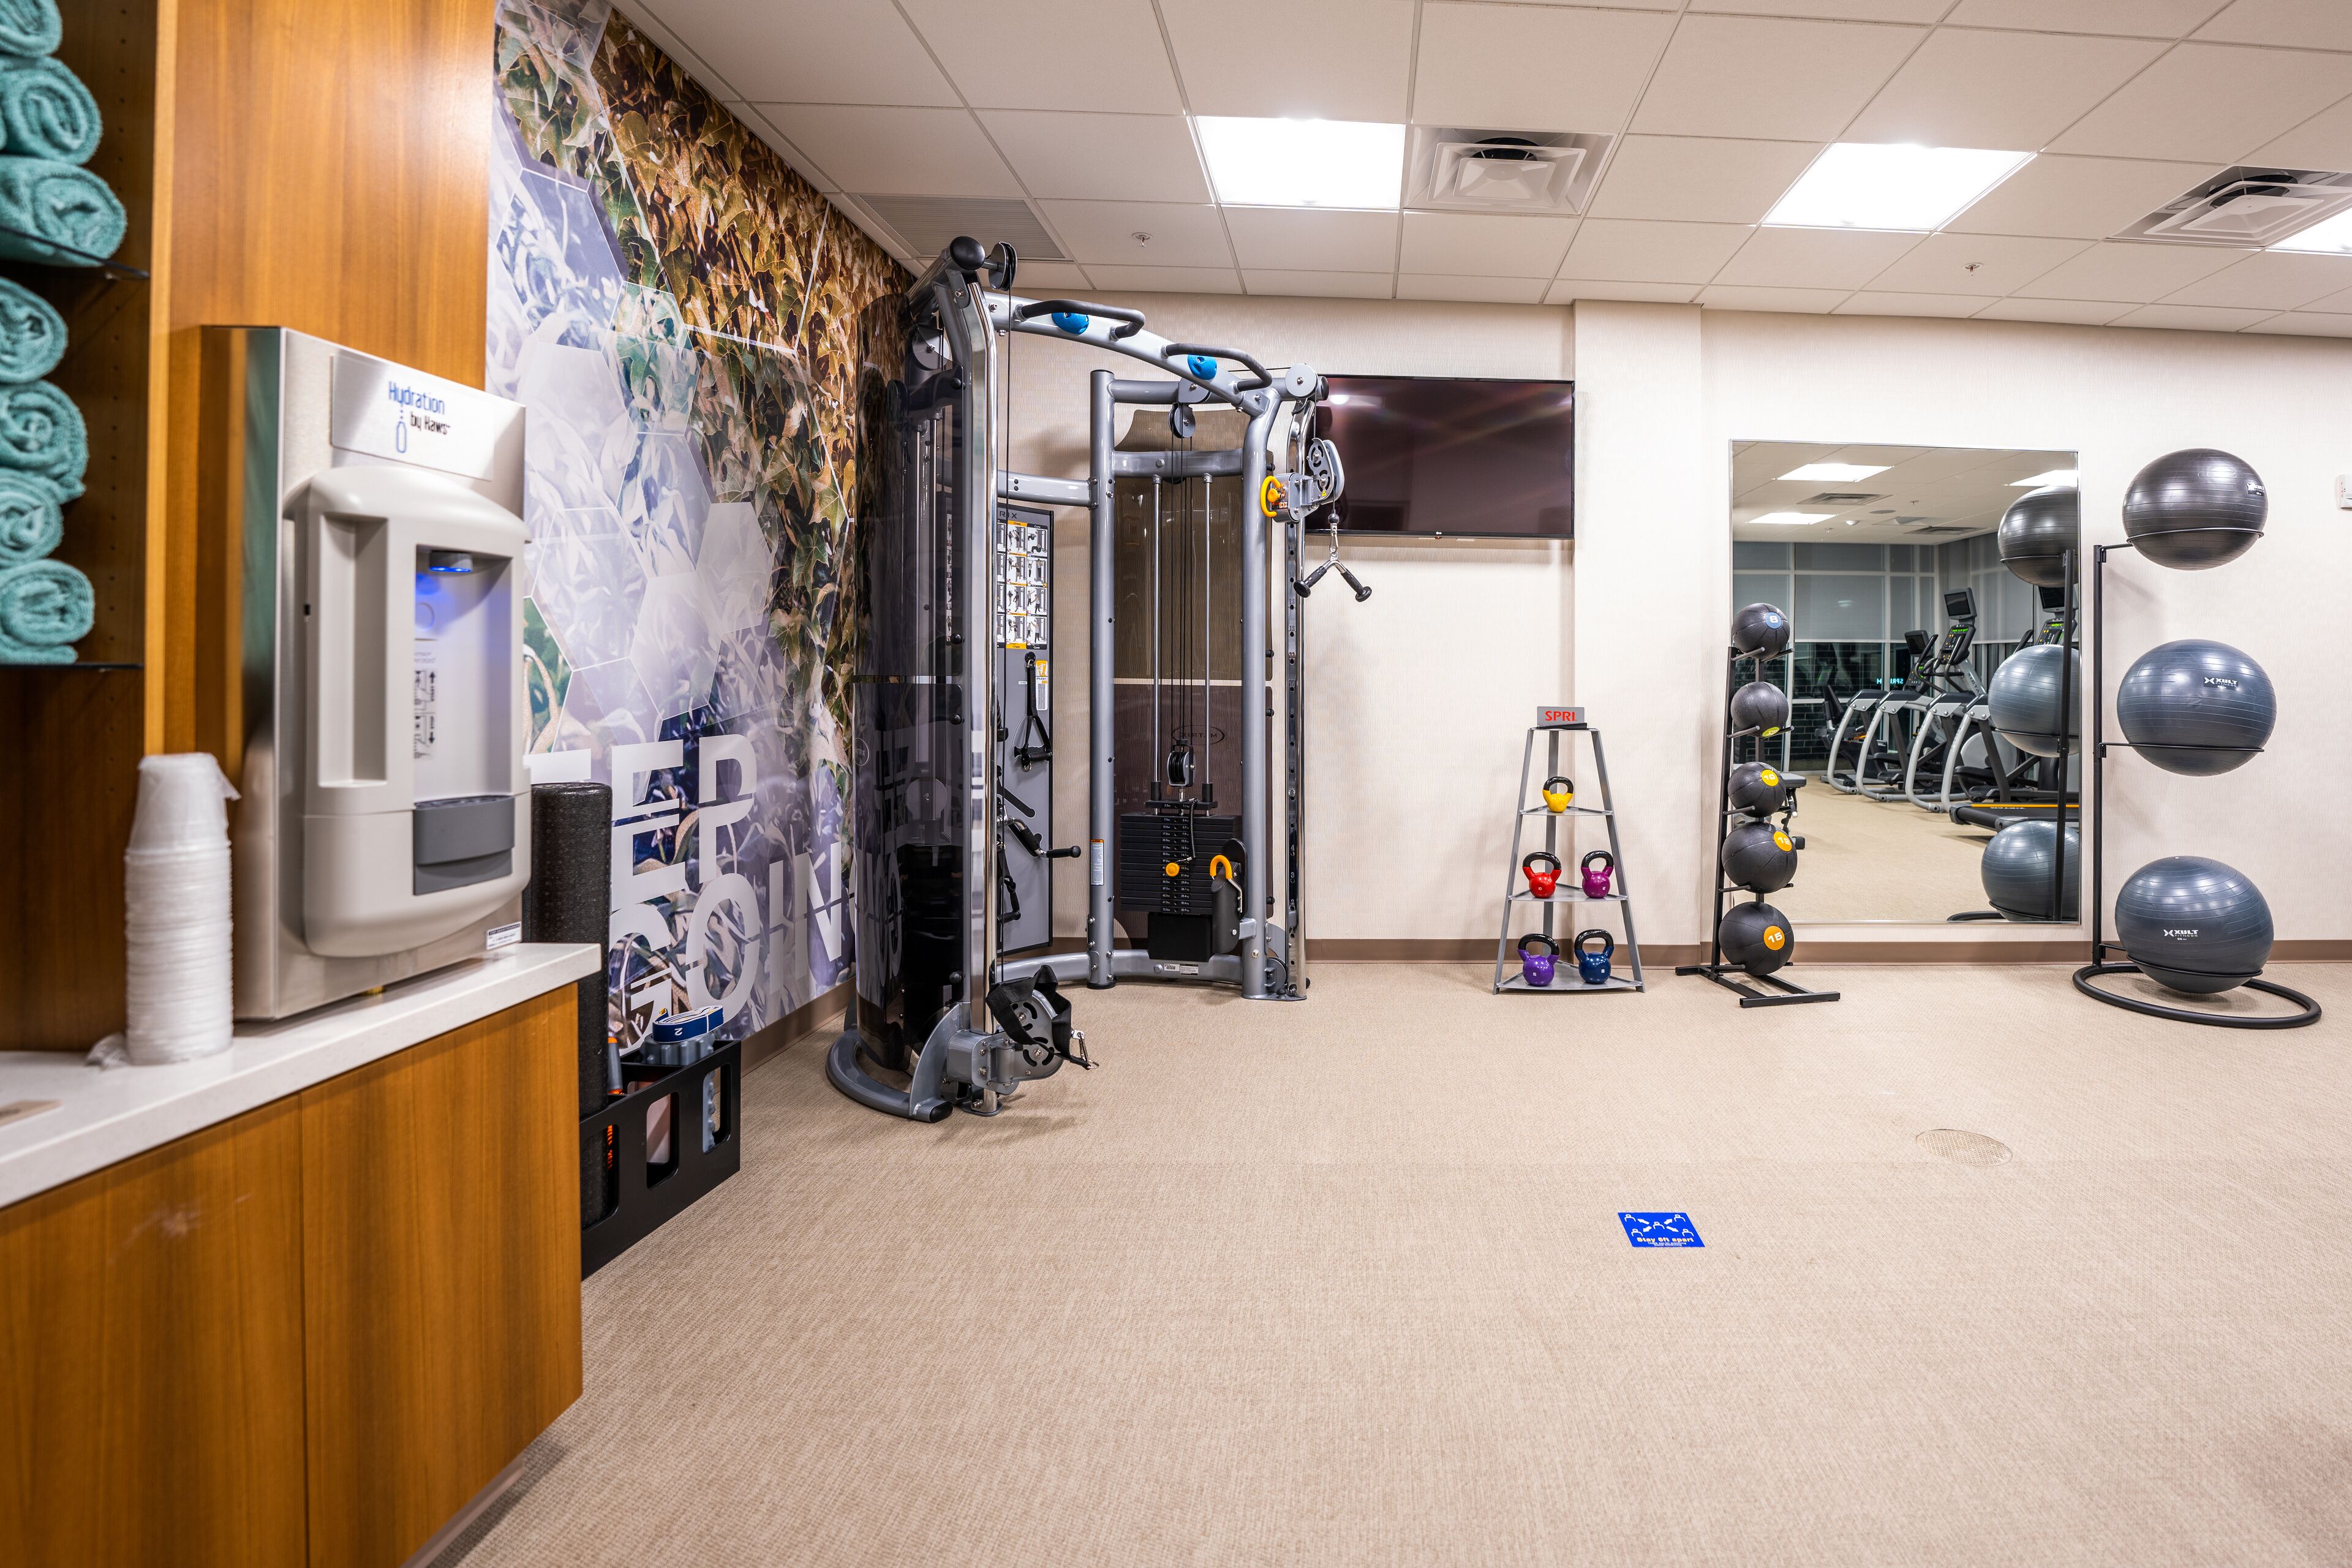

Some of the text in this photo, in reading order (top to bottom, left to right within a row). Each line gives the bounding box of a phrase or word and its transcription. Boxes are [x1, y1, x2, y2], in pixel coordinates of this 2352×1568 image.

[389, 381, 445, 415] Hydration
[410, 411, 421, 431] by
[1545, 710, 1575, 722] SPRI
[1777, 837, 1791, 845] 12
[1768, 932, 1783, 943] 15
[674, 1027, 683, 1036] 2
